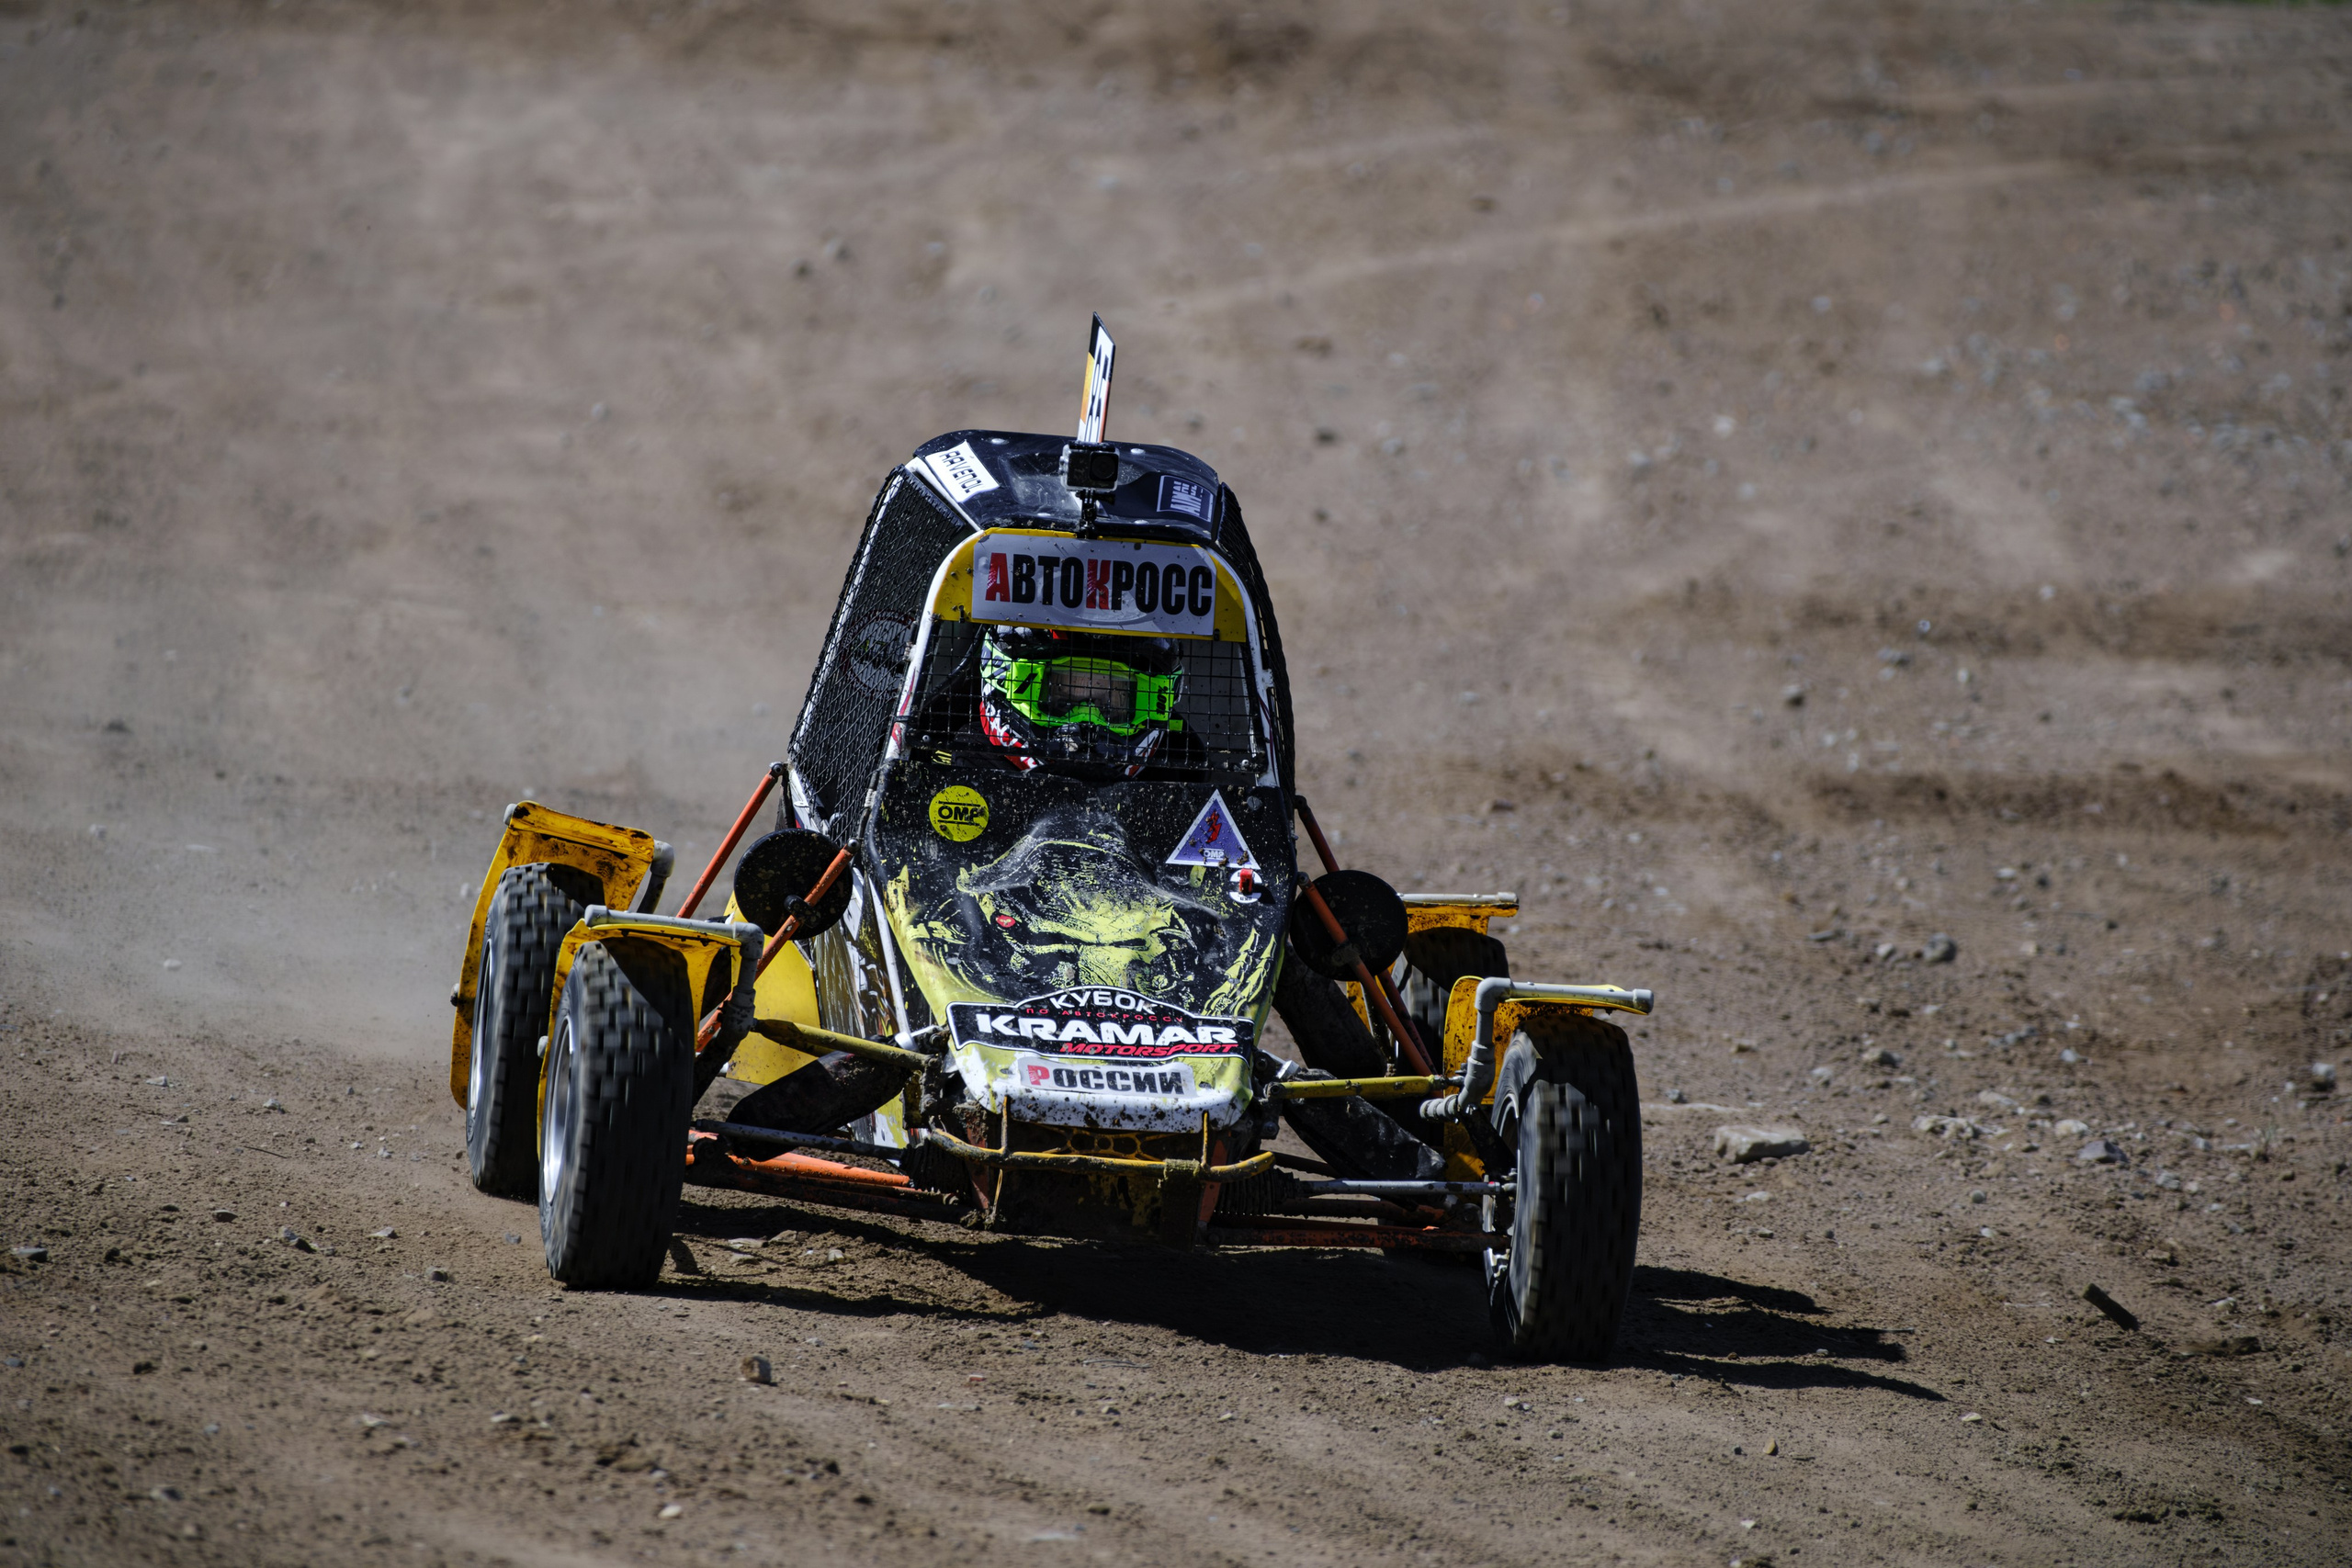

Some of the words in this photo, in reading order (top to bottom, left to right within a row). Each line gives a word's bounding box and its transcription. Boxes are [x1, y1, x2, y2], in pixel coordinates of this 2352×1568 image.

[939, 450, 983, 493] RAVENOL
[985, 552, 1212, 616] АВТОКРОСС
[938, 805, 983, 821] OMP
[1204, 850, 1225, 859] OMP
[1050, 990, 1158, 1014] КУБОК
[1062, 1010, 1182, 1022] АВТОКРОССУ
[976, 1014, 1238, 1045] KRAMAR
[1059, 1043, 1239, 1056] MOTORSPORT
[1027, 1065, 1184, 1094] РОССИИ
